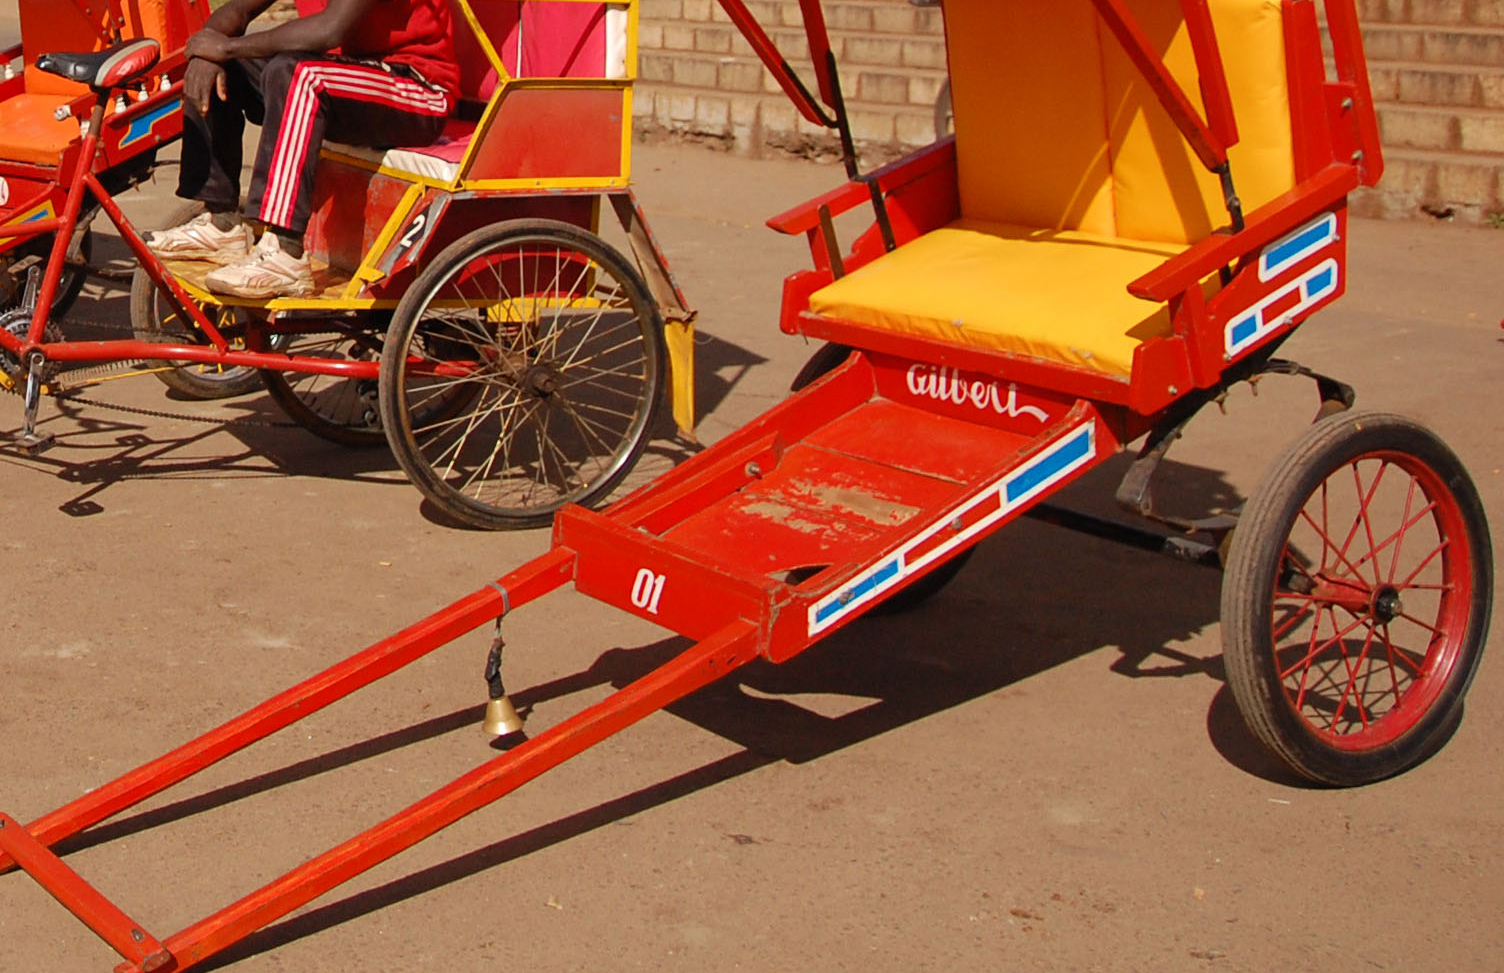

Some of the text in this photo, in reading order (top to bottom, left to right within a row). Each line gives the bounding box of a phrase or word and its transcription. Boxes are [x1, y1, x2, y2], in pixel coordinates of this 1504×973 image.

[399, 213, 426, 248] 2
[905, 363, 1050, 424] Gilbert
[631, 568, 666, 615] 01
